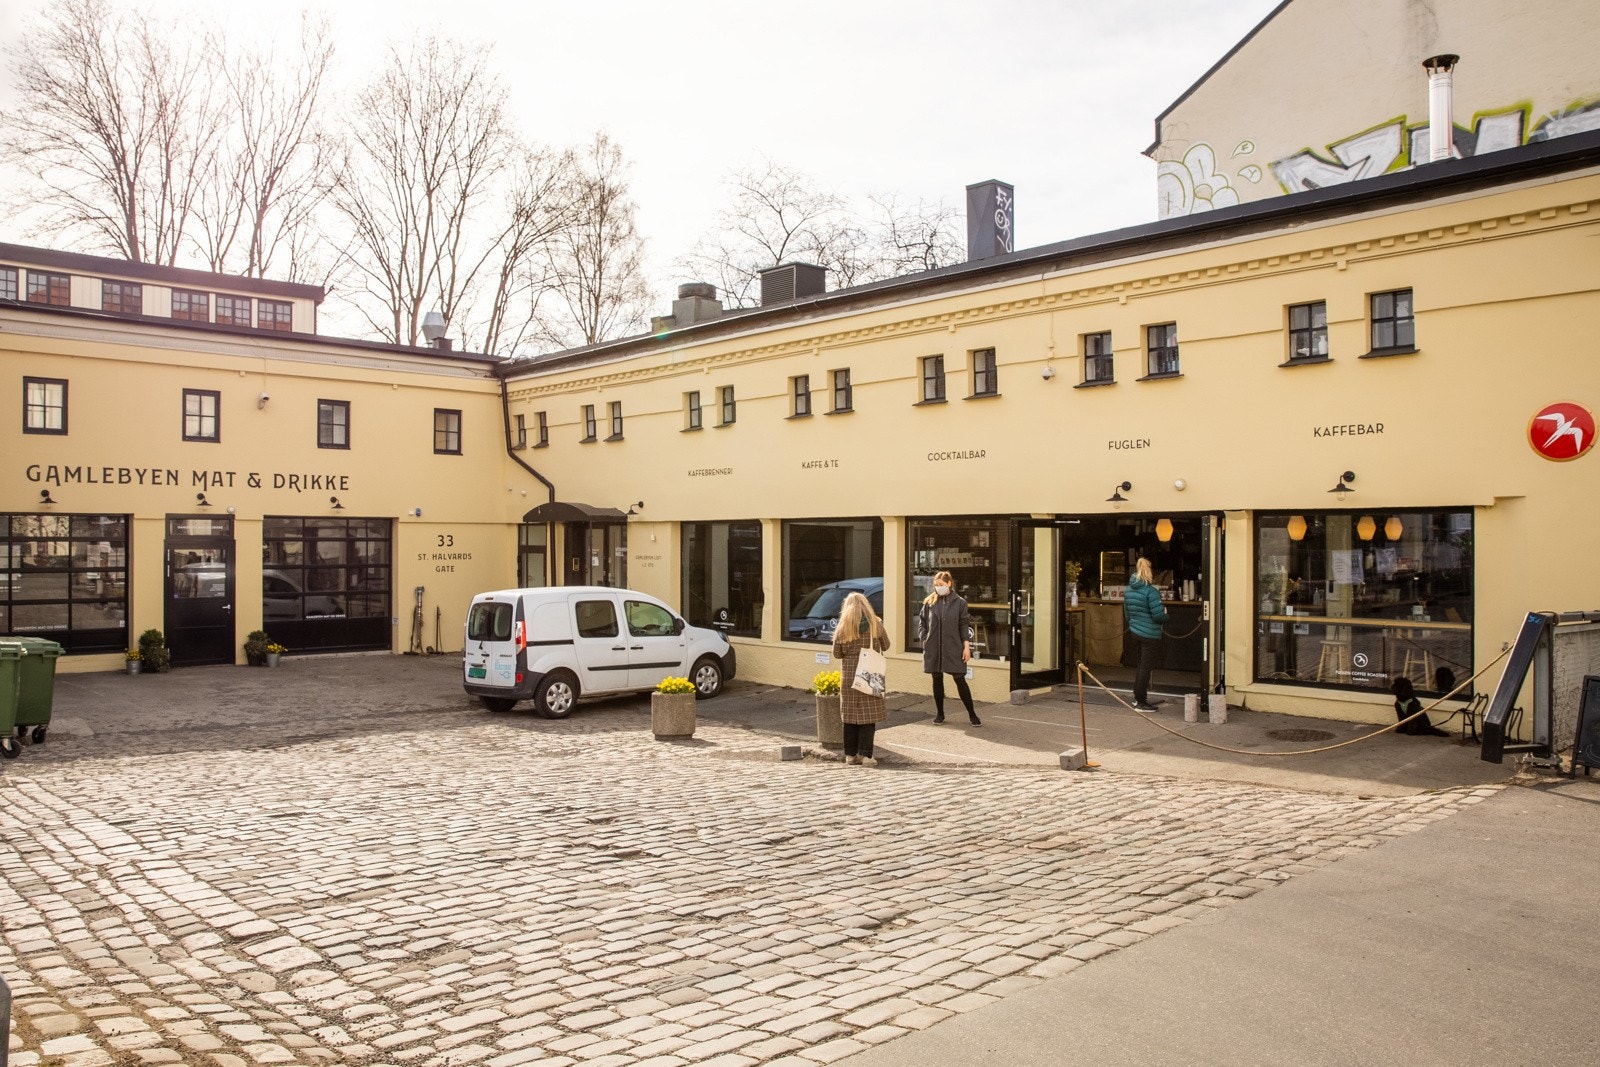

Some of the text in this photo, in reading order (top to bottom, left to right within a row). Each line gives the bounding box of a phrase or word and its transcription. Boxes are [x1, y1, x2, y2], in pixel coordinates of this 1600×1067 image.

[1313, 422, 1385, 438] KAFFEBAR
[1108, 438, 1151, 451] FUGLEN
[927, 449, 986, 462] COCKTAILBAR
[801, 459, 839, 469] KAFFE & TE
[25, 464, 349, 493] GAMLEBYEN MAT & DRIKKE
[687, 467, 733, 477] KAFFEBRENNERI
[437, 534, 454, 547] 33
[417, 553, 472, 561] ST. HALVARDS
[435, 565, 455, 573] GATE
